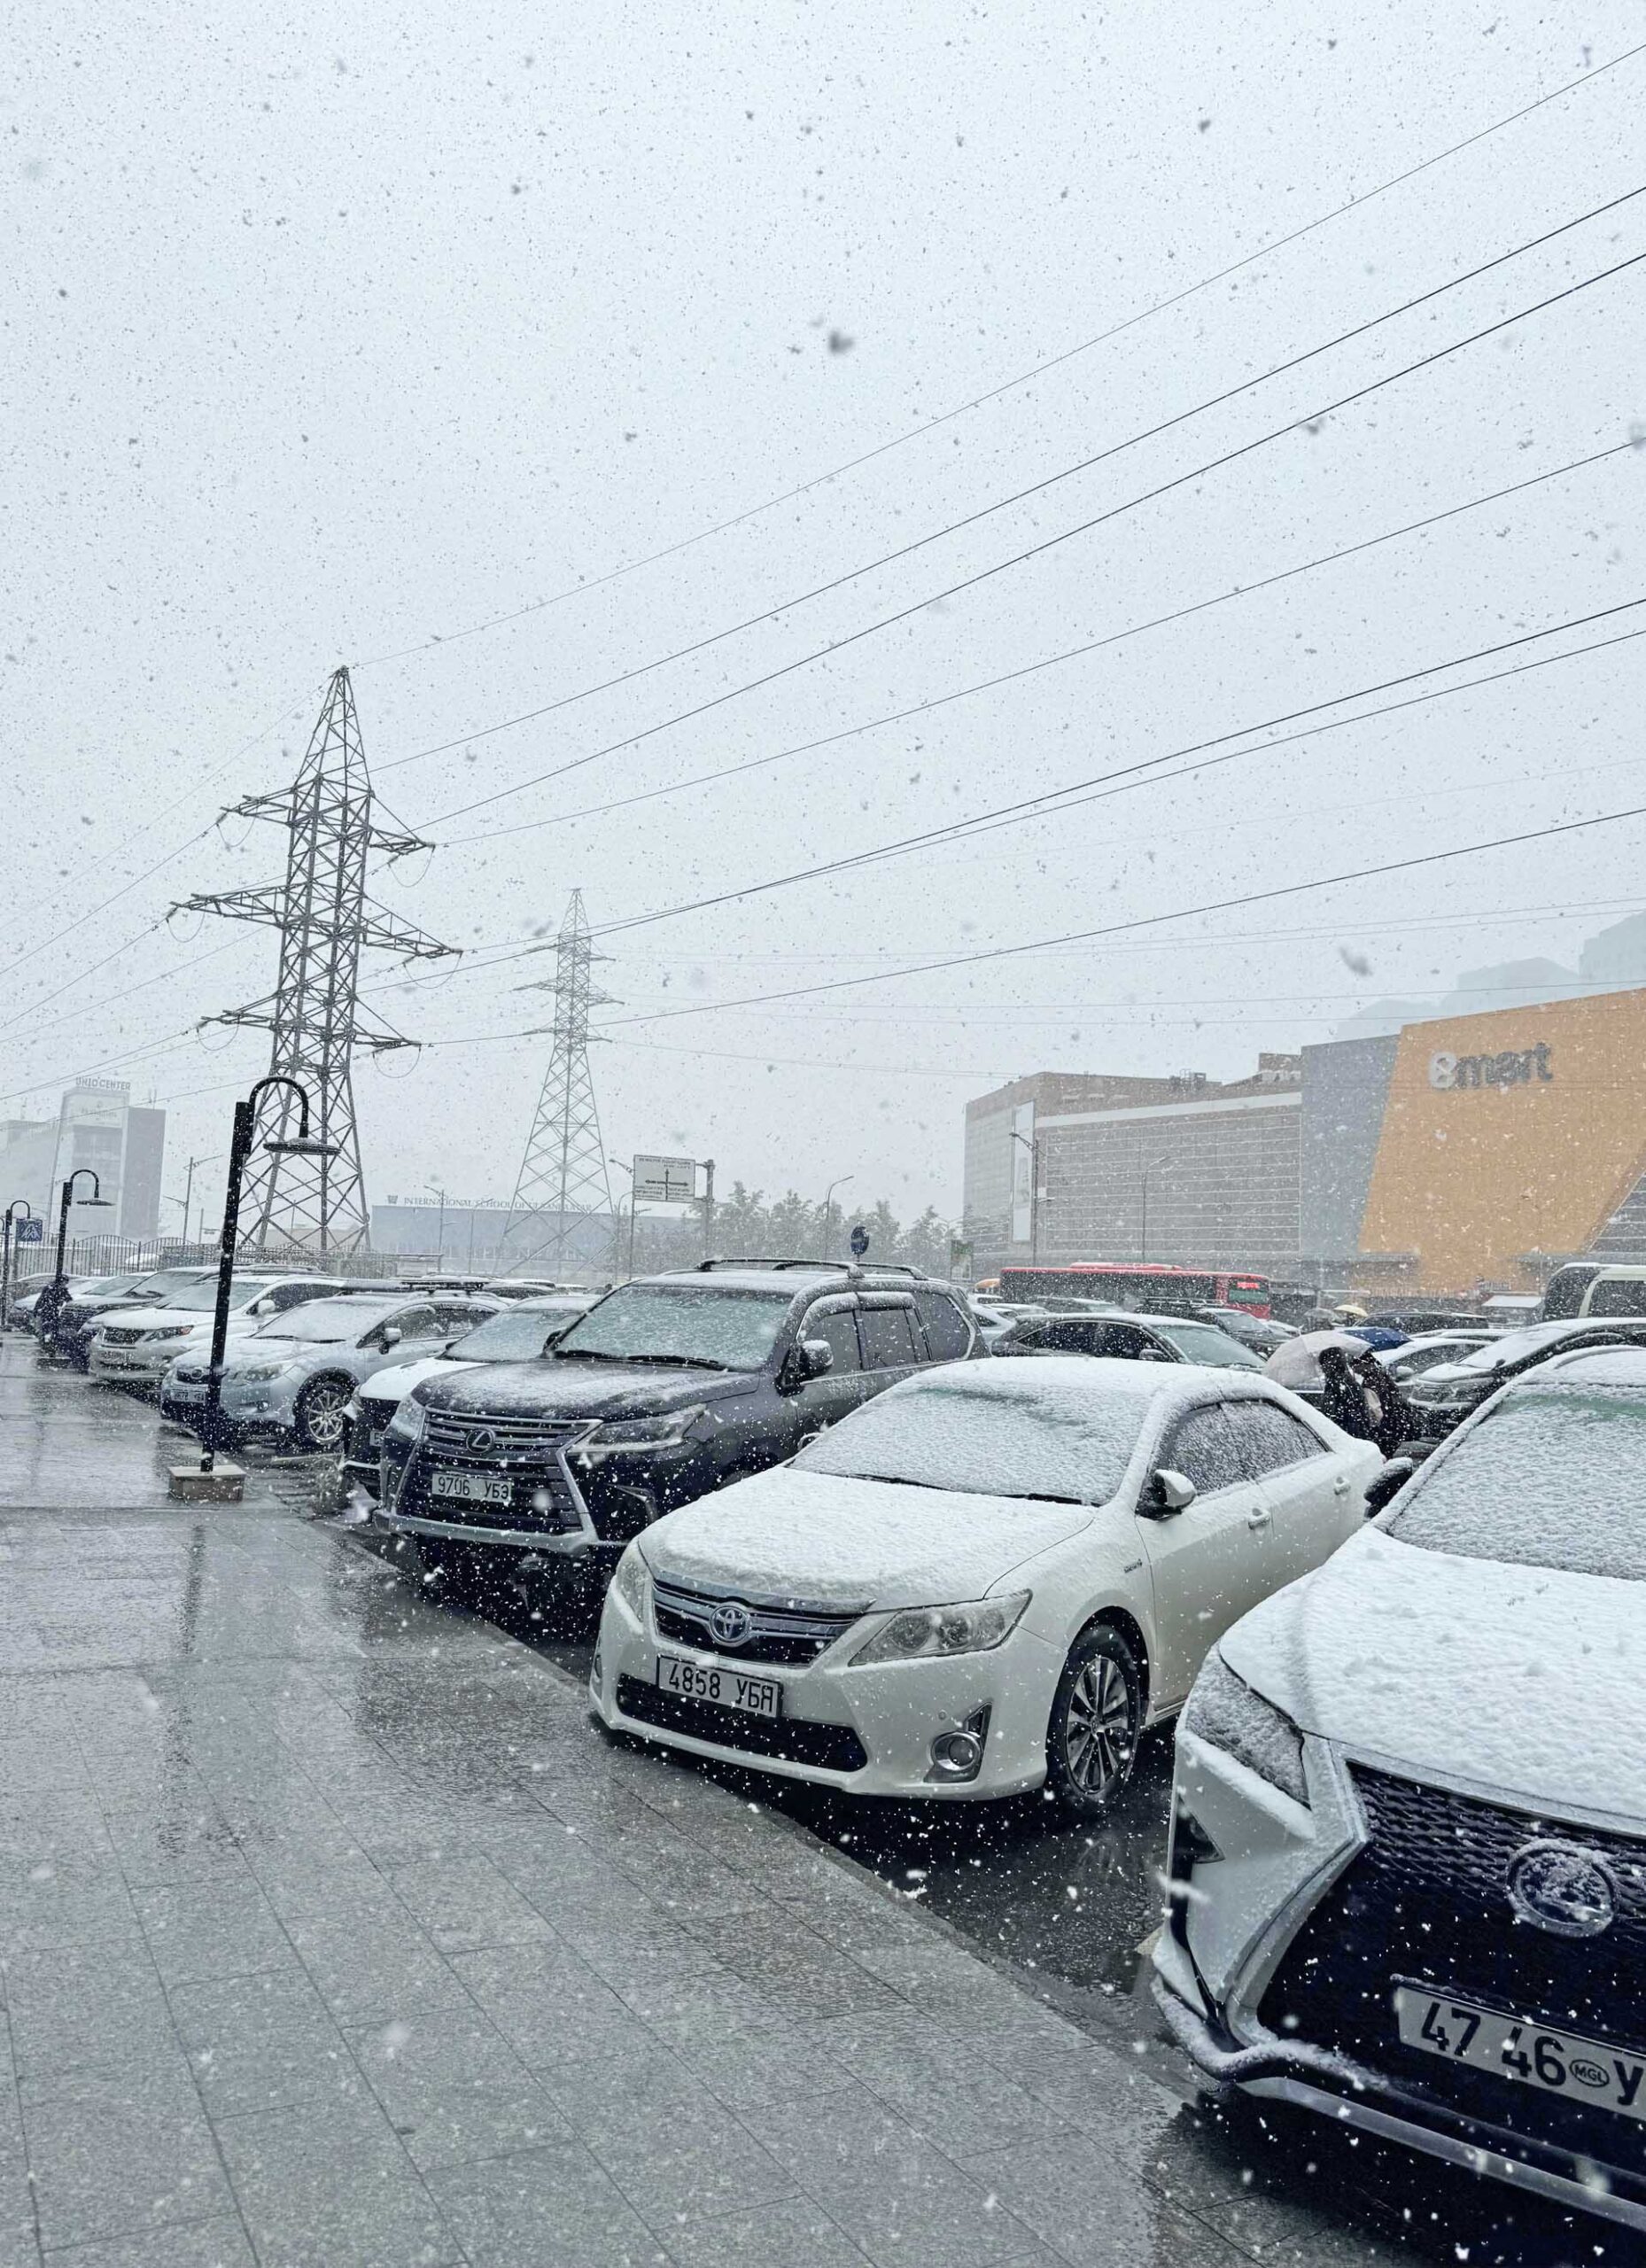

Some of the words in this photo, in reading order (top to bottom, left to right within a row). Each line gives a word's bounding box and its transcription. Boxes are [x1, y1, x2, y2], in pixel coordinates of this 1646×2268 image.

[438, 1475, 470, 1496] 9706
[483, 1481, 509, 1500] УБЭ
[669, 1664, 720, 1699] 4858
[735, 1678, 774, 1713] УБЯ
[1421, 2001, 1481, 2057] 47
[1502, 2026, 1567, 2087] 46
[1575, 2063, 1606, 2082] MGL
